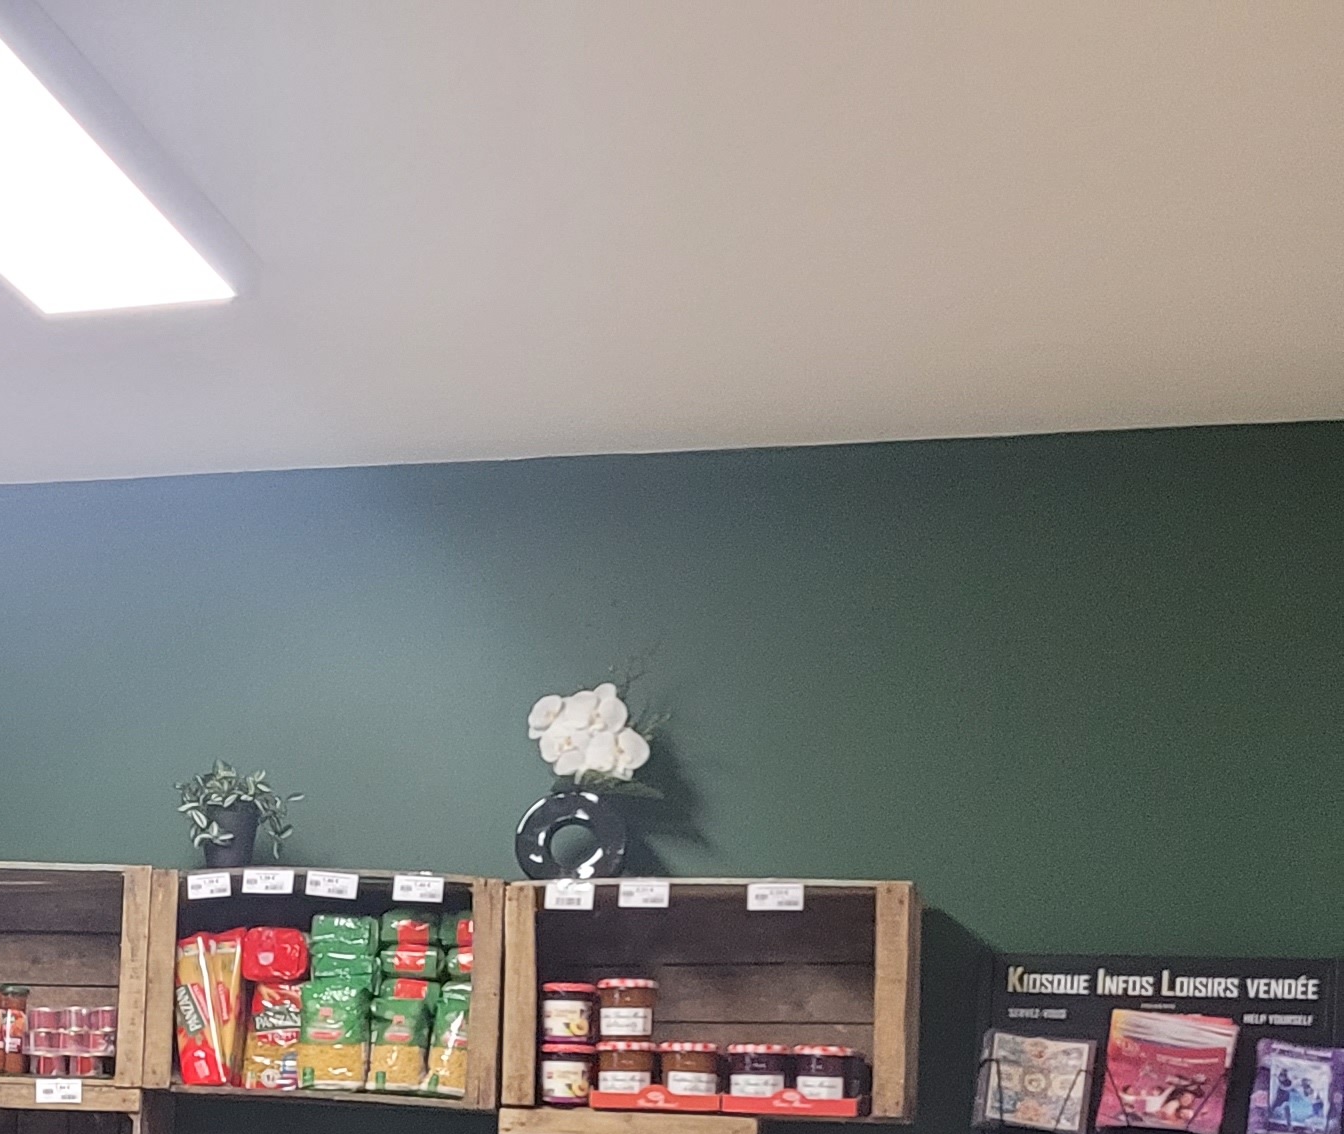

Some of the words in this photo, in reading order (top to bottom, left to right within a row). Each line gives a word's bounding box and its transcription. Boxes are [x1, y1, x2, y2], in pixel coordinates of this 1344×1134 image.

[1007, 966, 1091, 995] KIOSQUE
[1097, 968, 1155, 997] INFOS
[1161, 969, 1240, 999] LOISIRS
[1246, 975, 1319, 1000] VENDÉE
